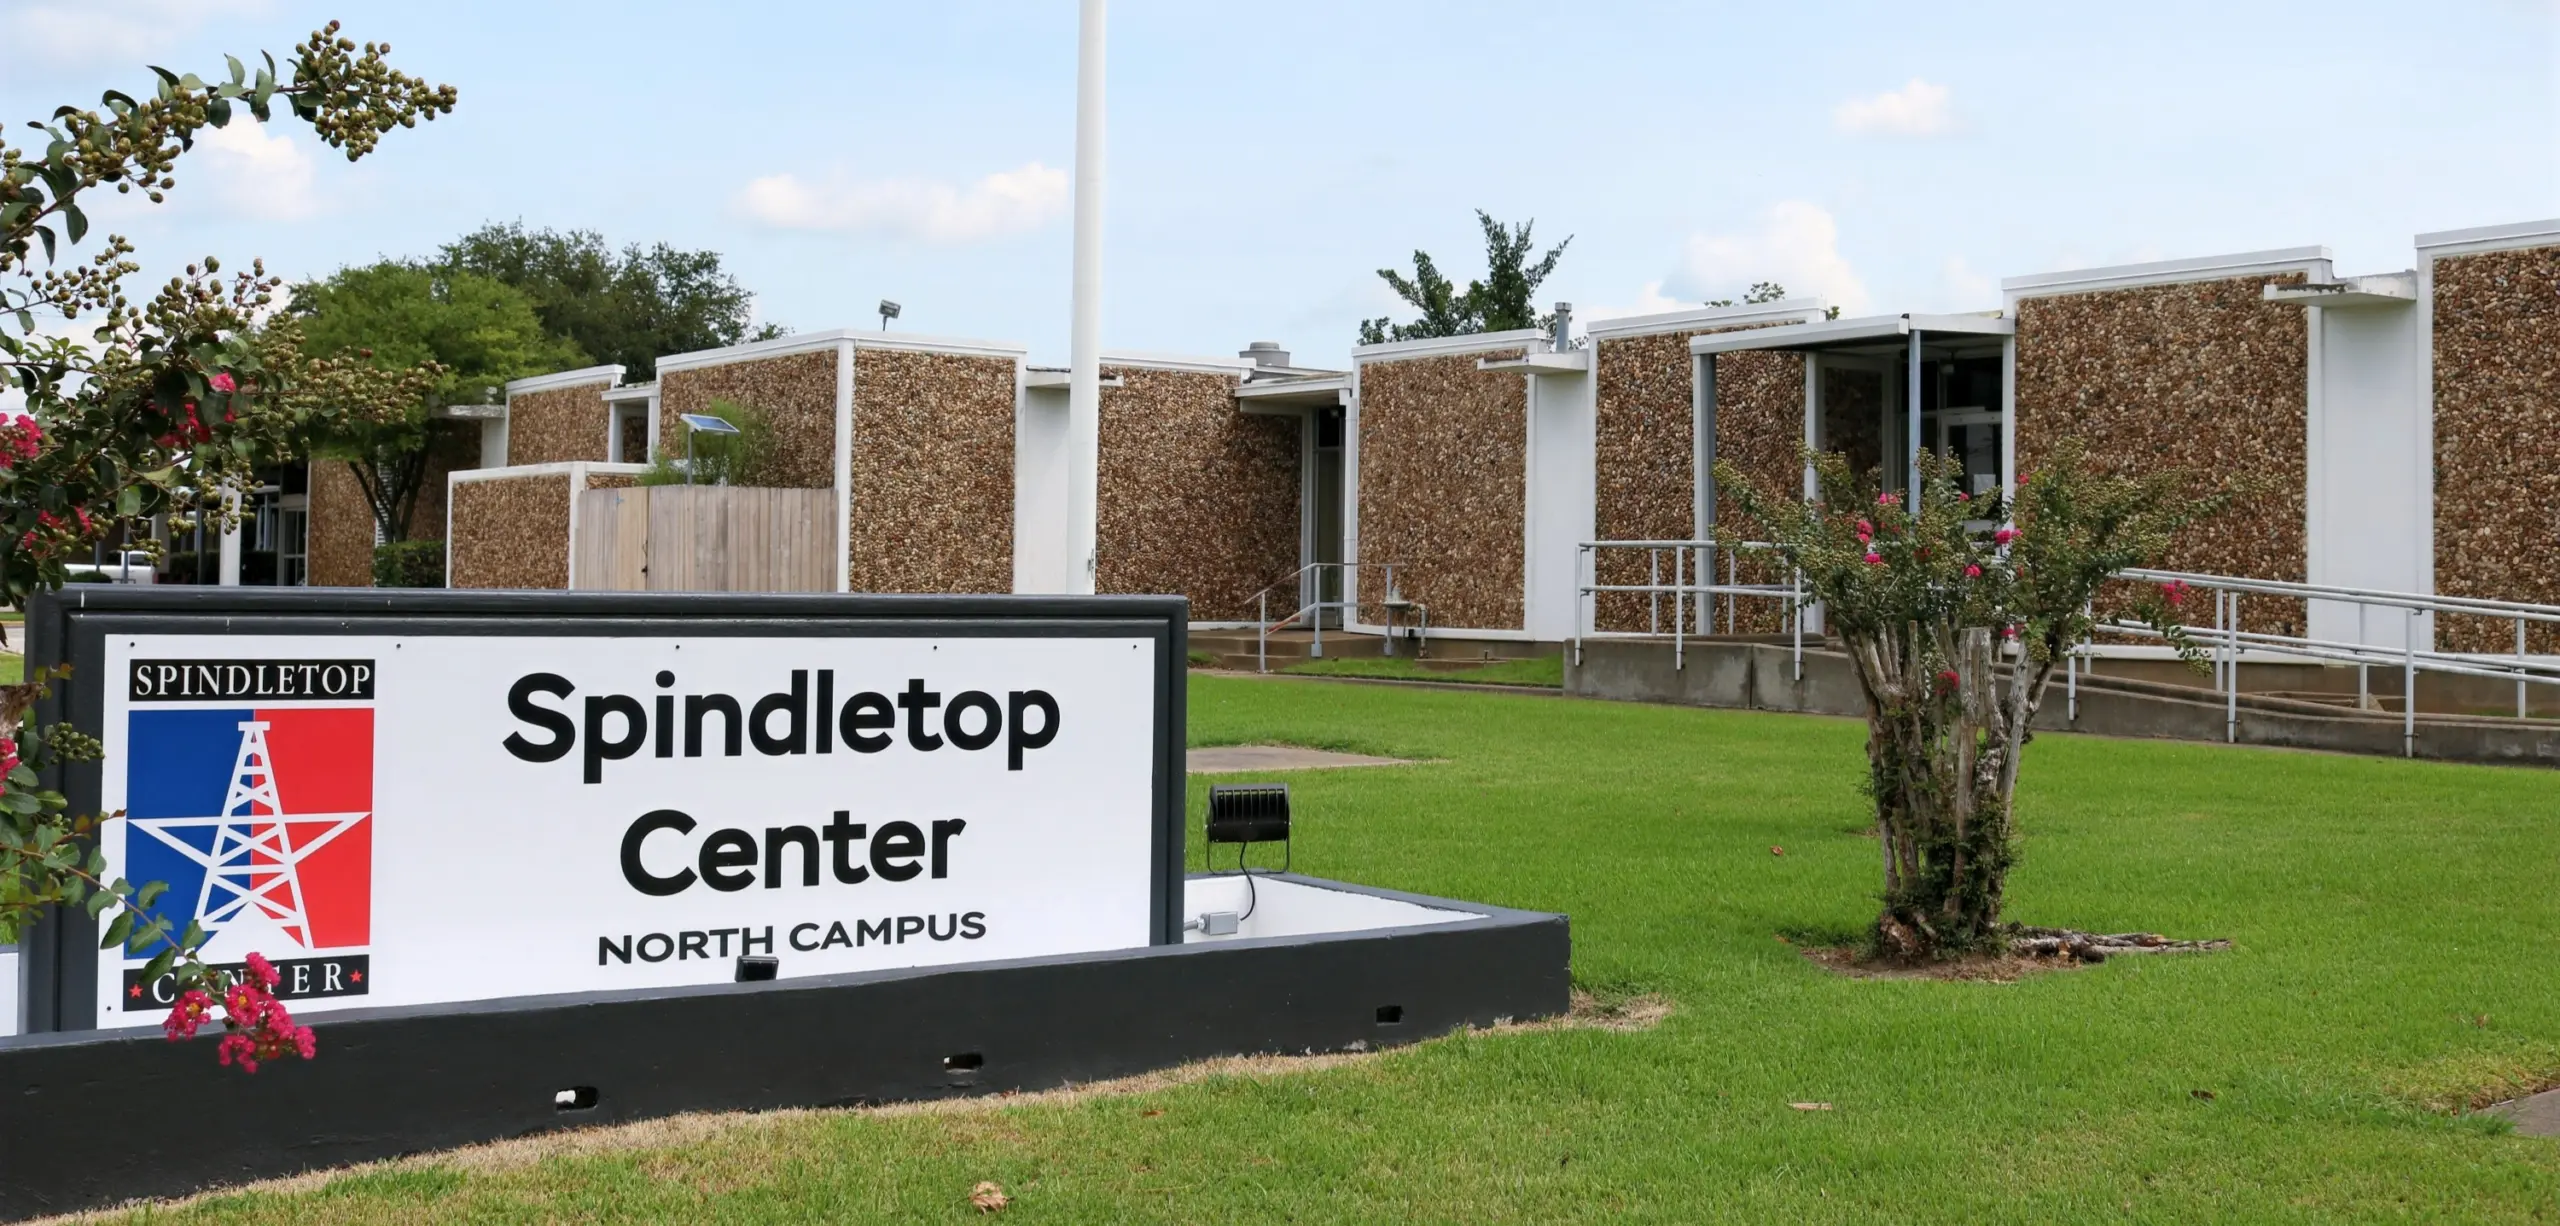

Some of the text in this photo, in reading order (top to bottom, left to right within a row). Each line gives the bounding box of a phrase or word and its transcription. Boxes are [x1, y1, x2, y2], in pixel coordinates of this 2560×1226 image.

[136, 664, 370, 696] SPINDLETOP
[503, 669, 1061, 785] Spindletop
[620, 809, 967, 897] Center
[598, 911, 987, 966] NORTH CAMPUS
[152, 962, 344, 1004] CNER
